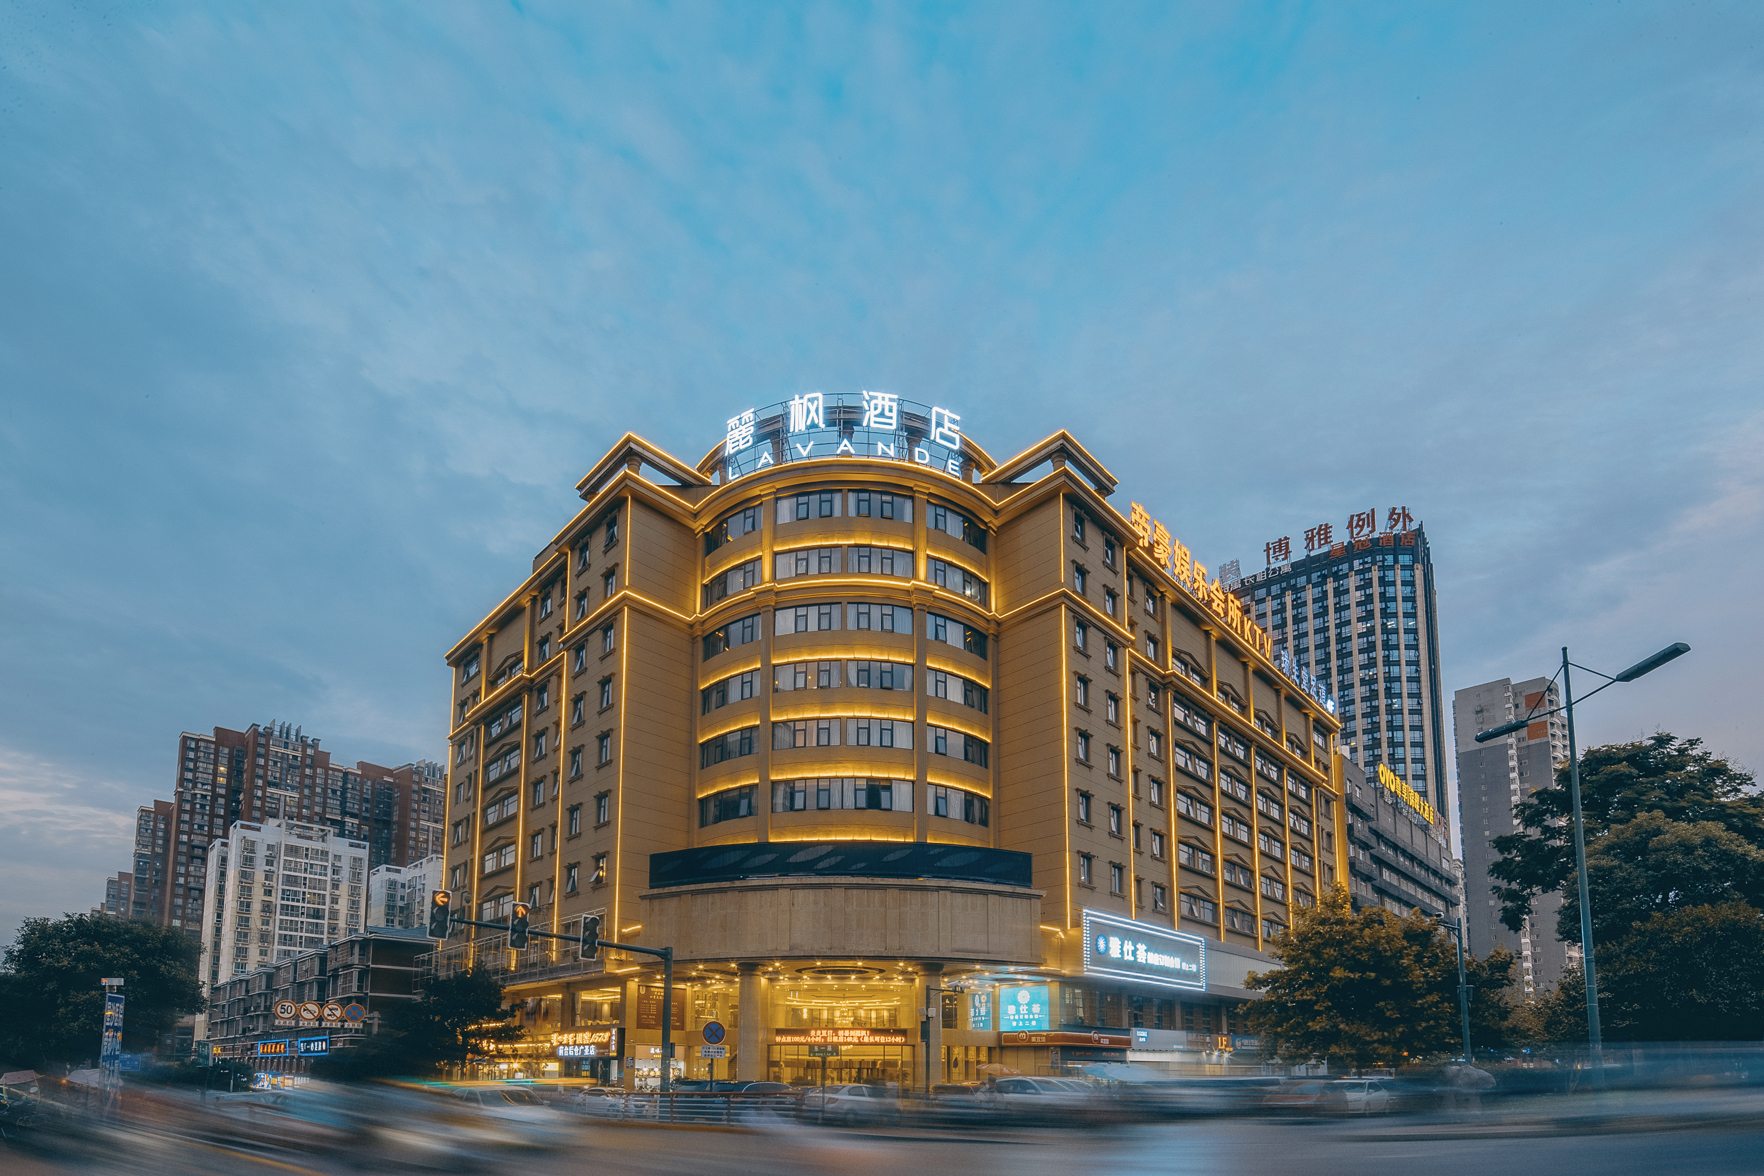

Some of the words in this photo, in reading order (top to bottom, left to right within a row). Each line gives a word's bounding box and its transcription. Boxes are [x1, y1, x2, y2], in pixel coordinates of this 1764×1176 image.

[728, 438, 960, 480] LAVANDE
[1263, 505, 1415, 566] 博雅例外
[279, 1004, 294, 1015] 50
[1218, 1036, 1228, 1049] LF
